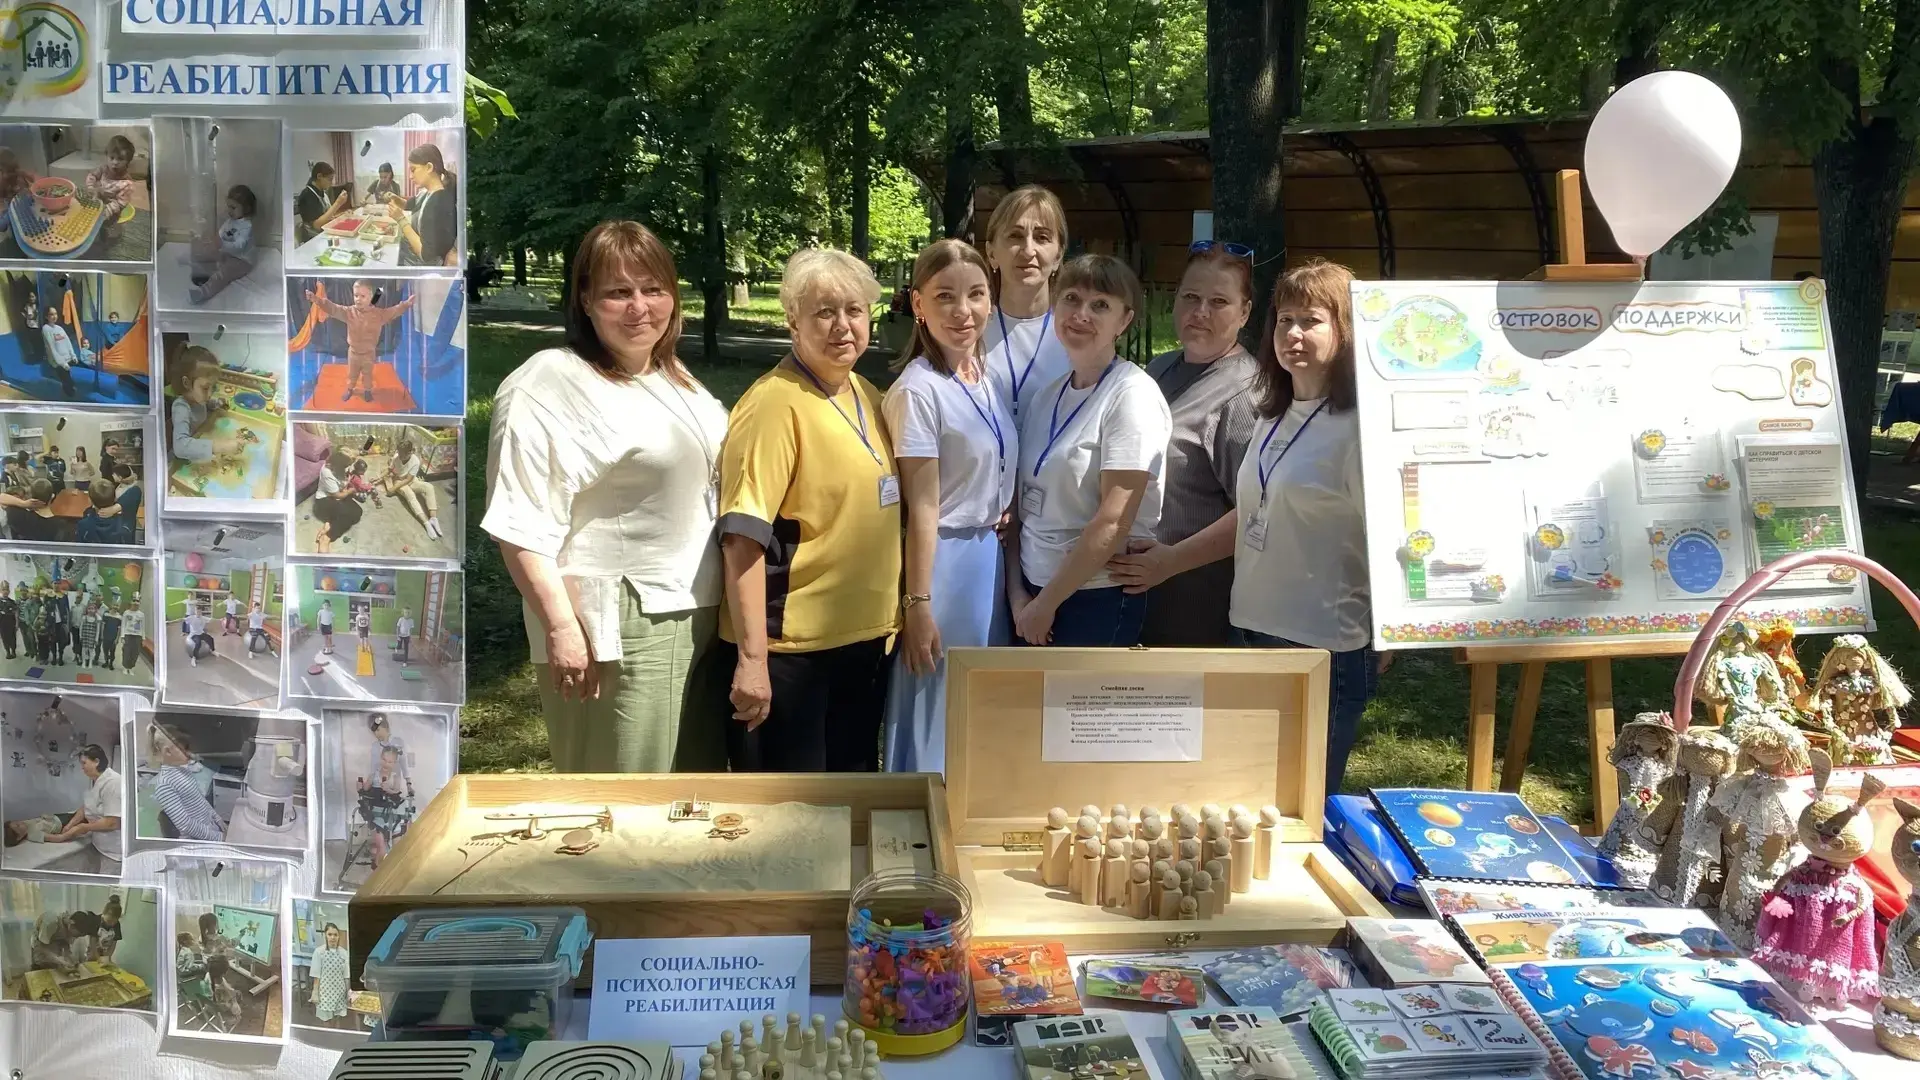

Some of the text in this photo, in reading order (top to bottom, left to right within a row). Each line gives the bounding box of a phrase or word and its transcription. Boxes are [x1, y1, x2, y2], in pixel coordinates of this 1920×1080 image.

[125, 0, 424, 31] СОЦИАЛЬНАЯ
[107, 62, 450, 101] РЕАБИЛИТАЦИЯ
[1491, 312, 1599, 328] ОСТРОВОК
[1616, 310, 1741, 328] ПОДДЕРЖКИ
[640, 955, 765, 973] СОЦИАЛЬНО-
[605, 975, 797, 993] ПСИХОЛОГИЧЕСКАЯ
[1236, 979, 1281, 994] ПАПА
[624, 997, 776, 1013] РЕАБИЛИТАЦИЯ
